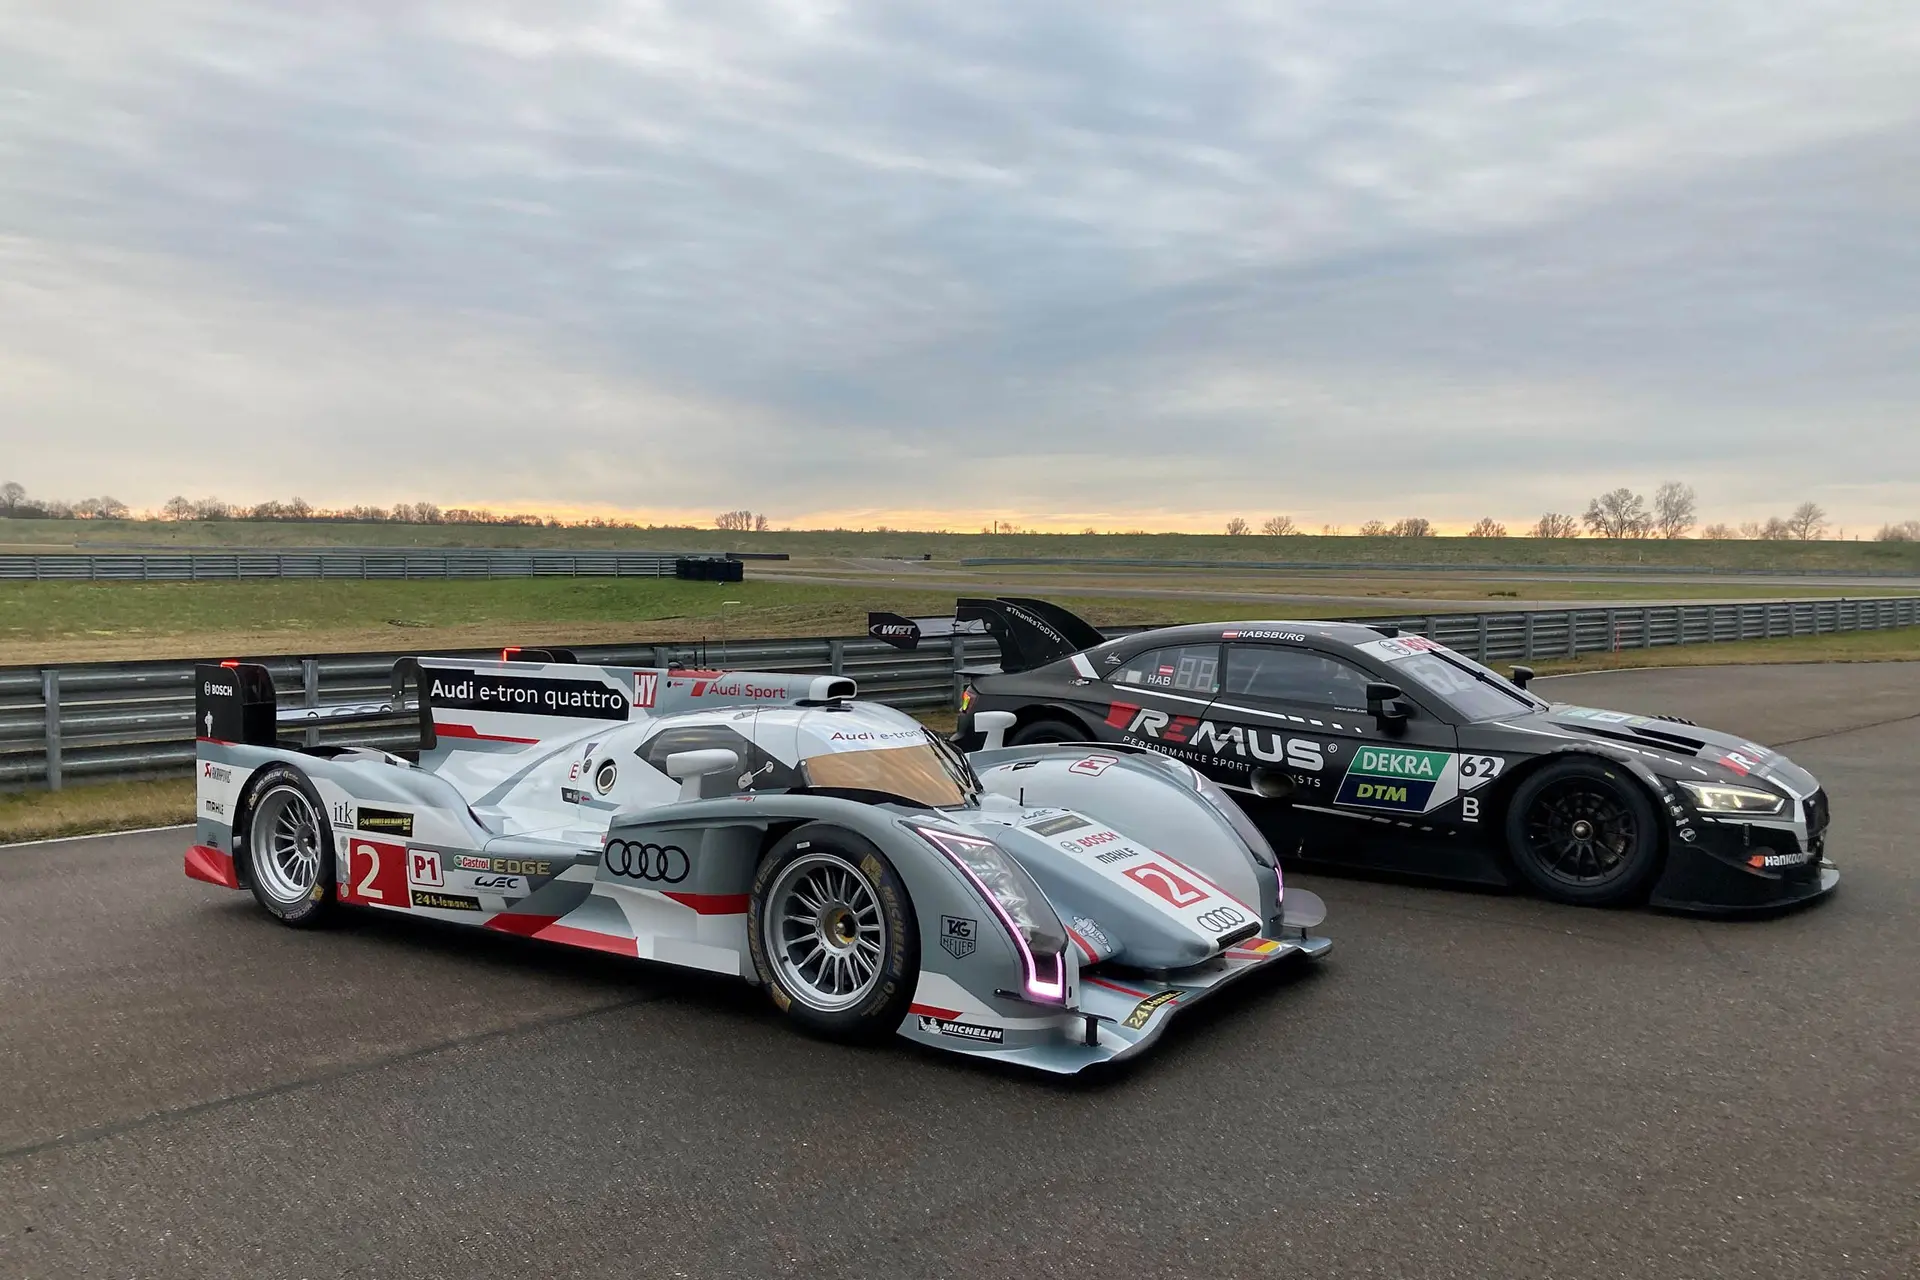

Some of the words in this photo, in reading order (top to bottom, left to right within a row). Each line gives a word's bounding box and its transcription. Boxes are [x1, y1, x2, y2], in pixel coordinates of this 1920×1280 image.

[881, 625, 916, 634] WRT
[1006, 606, 1061, 643] #ThanksToDTM
[1237, 630, 1305, 642] HABSBURG
[1147, 674, 1171, 686] HAB
[211, 684, 233, 696] BOSCH
[431, 679, 474, 699] Audi
[480, 685, 538, 704] e-tron
[545, 689, 622, 710] quattro
[634, 674, 657, 705] HY
[709, 682, 741, 697] Audi
[745, 684, 786, 700] Sport
[831, 732, 875, 741] Audi
[880, 730, 919, 740] e-tron
[1128, 708, 1324, 772] REMUS
[1122, 735, 1207, 763] PERFORMANCE
[1212, 757, 1251, 772] SPORT
[570, 764, 579, 779] E
[1078, 760, 1109, 770] P1
[1362, 752, 1433, 776] DEKRA
[1461, 757, 1496, 778] 62
[1356, 783, 1407, 802] DTM
[334, 801, 354, 824] itk
[1462, 797, 1480, 817] B
[1076, 831, 1120, 847] BOSCH
[1095, 847, 1139, 864] MAHLE
[356, 844, 383, 899] 2
[414, 855, 437, 880] P1
[462, 857, 489, 870] Castrol
[493, 858, 551, 875] EDGE
[474, 876, 519, 889] WEC
[1134, 868, 1201, 904] 2
[947, 919, 971, 937] TAG
[943, 938, 973, 957] HEUER
[942, 1022, 1002, 1039] MICHELIN
